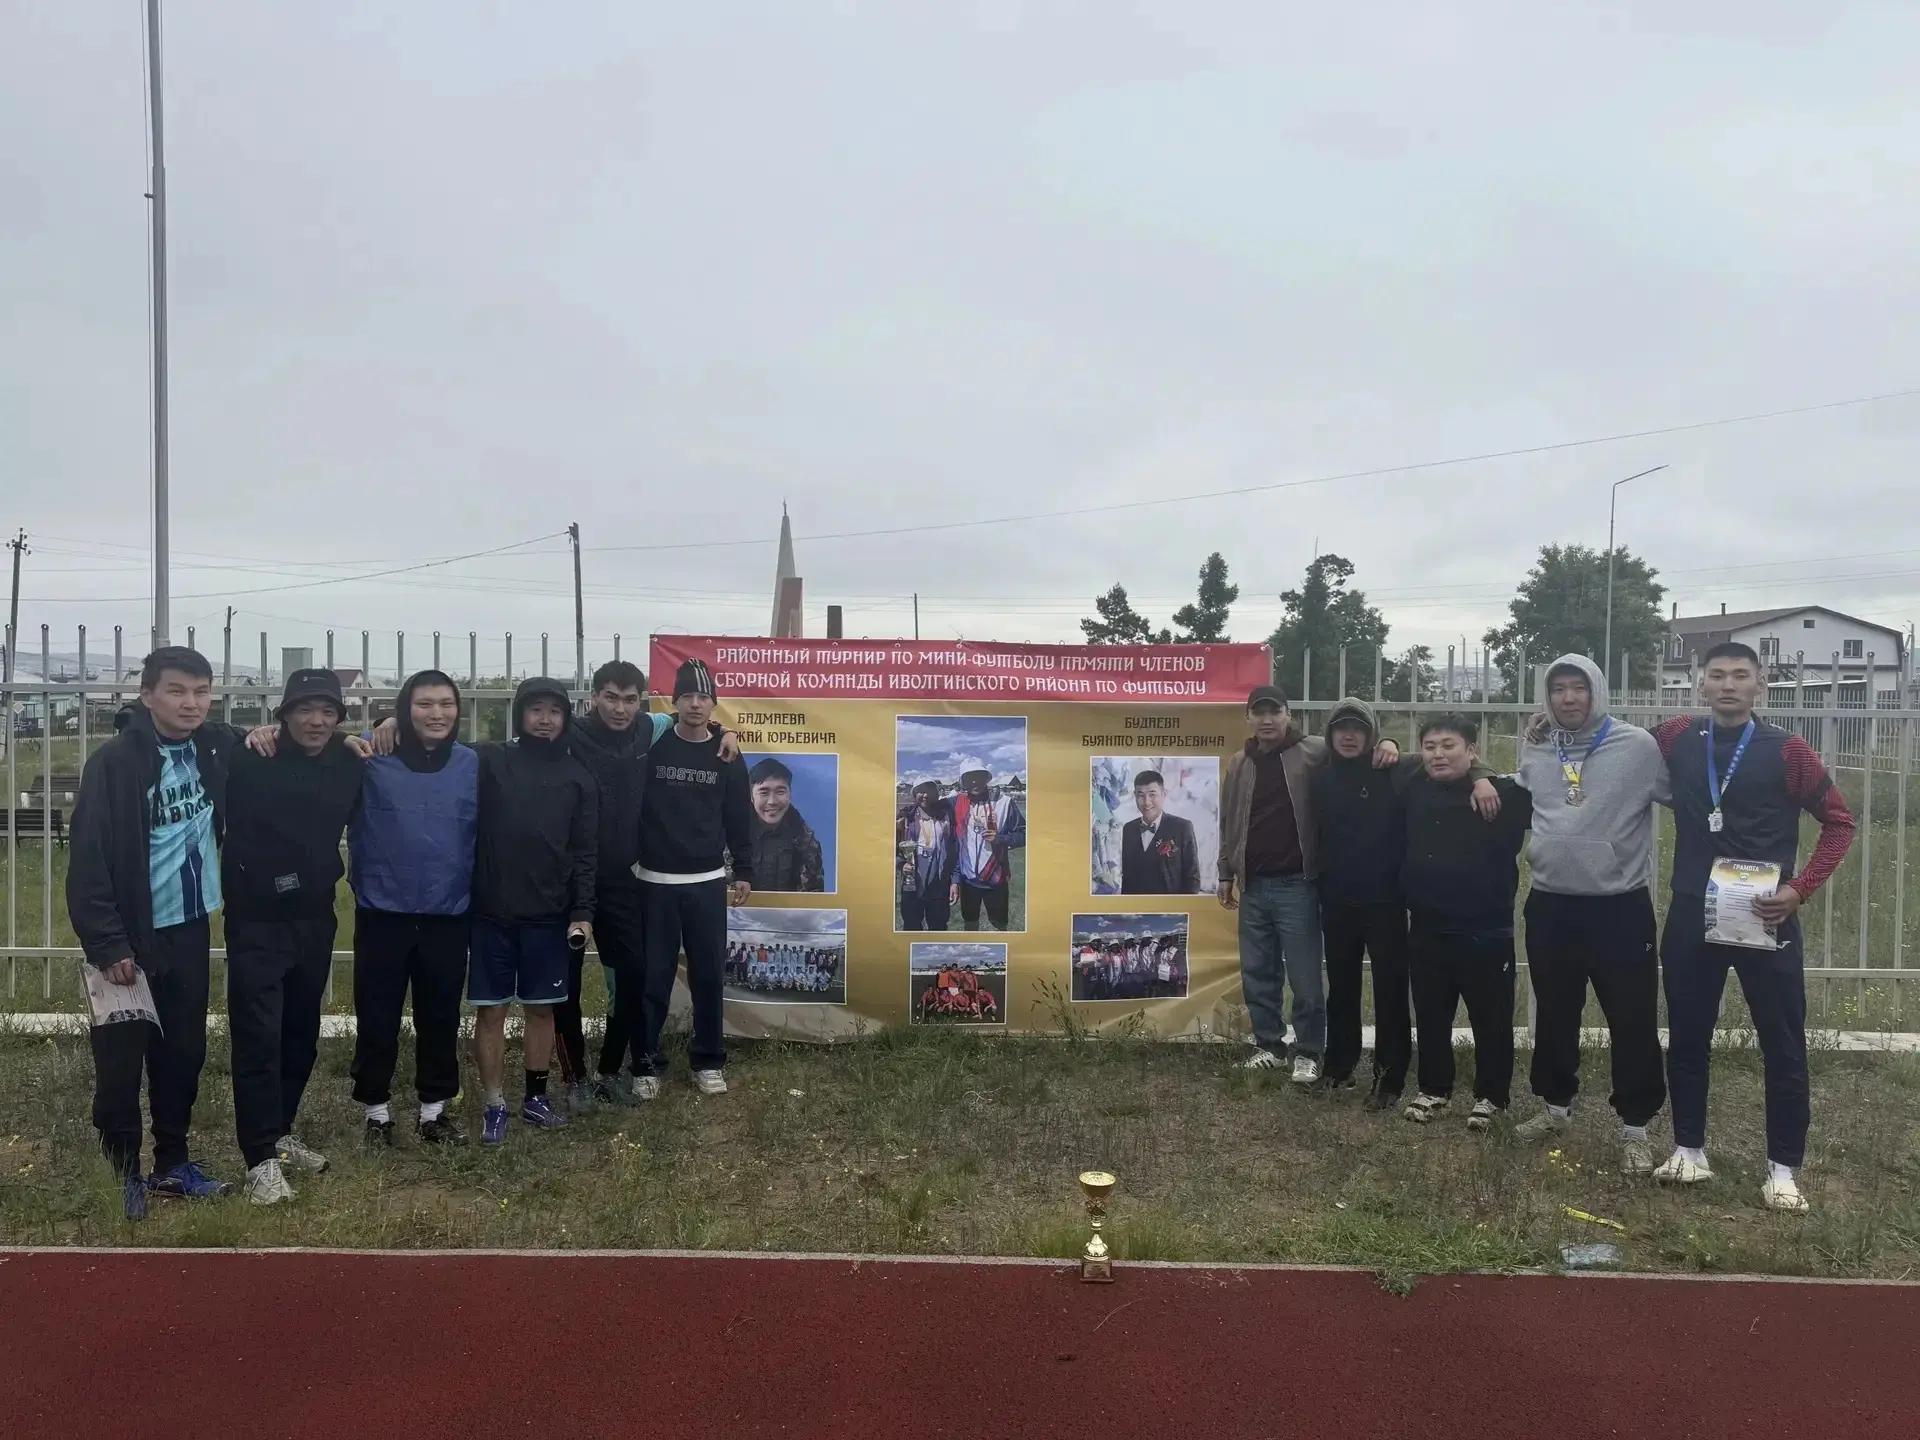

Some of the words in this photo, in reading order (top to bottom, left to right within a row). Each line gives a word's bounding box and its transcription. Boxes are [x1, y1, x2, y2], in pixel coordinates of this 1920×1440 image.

[716, 647, 810, 664] РАЙОННЫЙ
[816, 650, 885, 664] ТУРНИР
[891, 651, 913, 665] ПО
[1060, 655, 1134, 671] ПАМЯТИ
[1140, 656, 1205, 671] ЧЛЕНОВ
[714, 671, 790, 688] СБОРНОЙ
[796, 673, 882, 690] КОМАНДЫ
[889, 674, 1020, 690] ИВОЛГИНСКОГО
[1025, 676, 1091, 692] РАЙОНА
[1096, 680, 1118, 693] ПО
[1122, 680, 1206, 695] ФУТБОЛУ
[738, 713, 806, 725] БАДМАЕВА
[1124, 717, 1180, 730] БУДАЕВА
[767, 731, 836, 744] ЮРЬЕВИЧА
[1082, 735, 1133, 747] БУЯНТО
[1137, 735, 1225, 748] ВАЛЕРЬЕВИЧА
[655, 765, 718, 785] BOSTON
